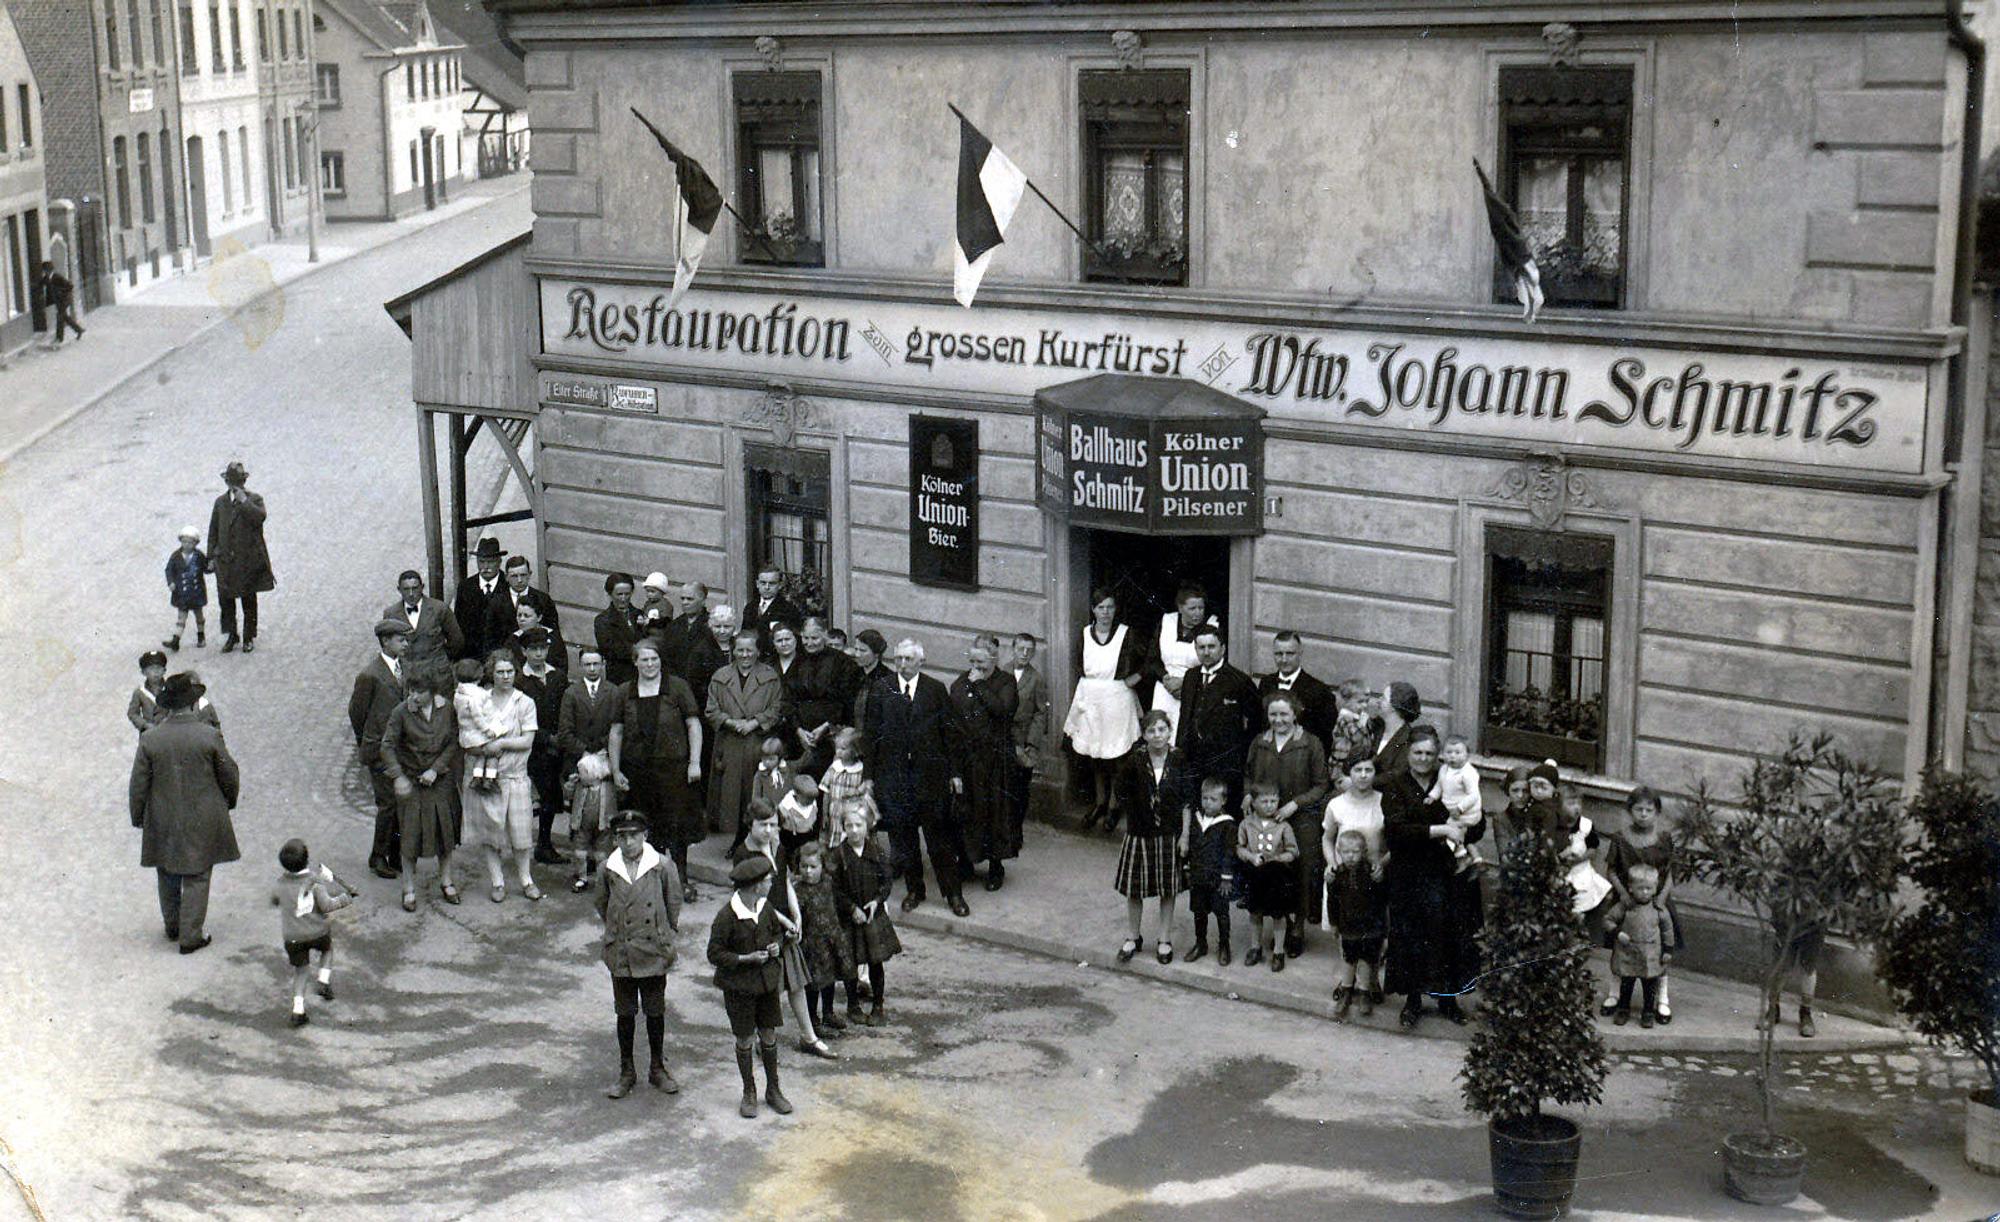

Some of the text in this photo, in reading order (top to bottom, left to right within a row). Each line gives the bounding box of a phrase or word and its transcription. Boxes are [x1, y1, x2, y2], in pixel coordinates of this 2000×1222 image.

[564, 287, 852, 362] Restauration
[904, 326, 1026, 370] grossen
[1033, 329, 1188, 376] Kurfürst
[1201, 350, 1232, 379] von
[1346, 342, 1570, 426] Johann
[1575, 356, 1880, 449] Schmitz
[1071, 424, 1148, 467] Ballhaus
[1165, 433, 1244, 452] Kölner
[921, 473, 963, 497] Kölner
[1073, 470, 1144, 514] Schmitz
[1162, 497, 1247, 517] Pilsener
